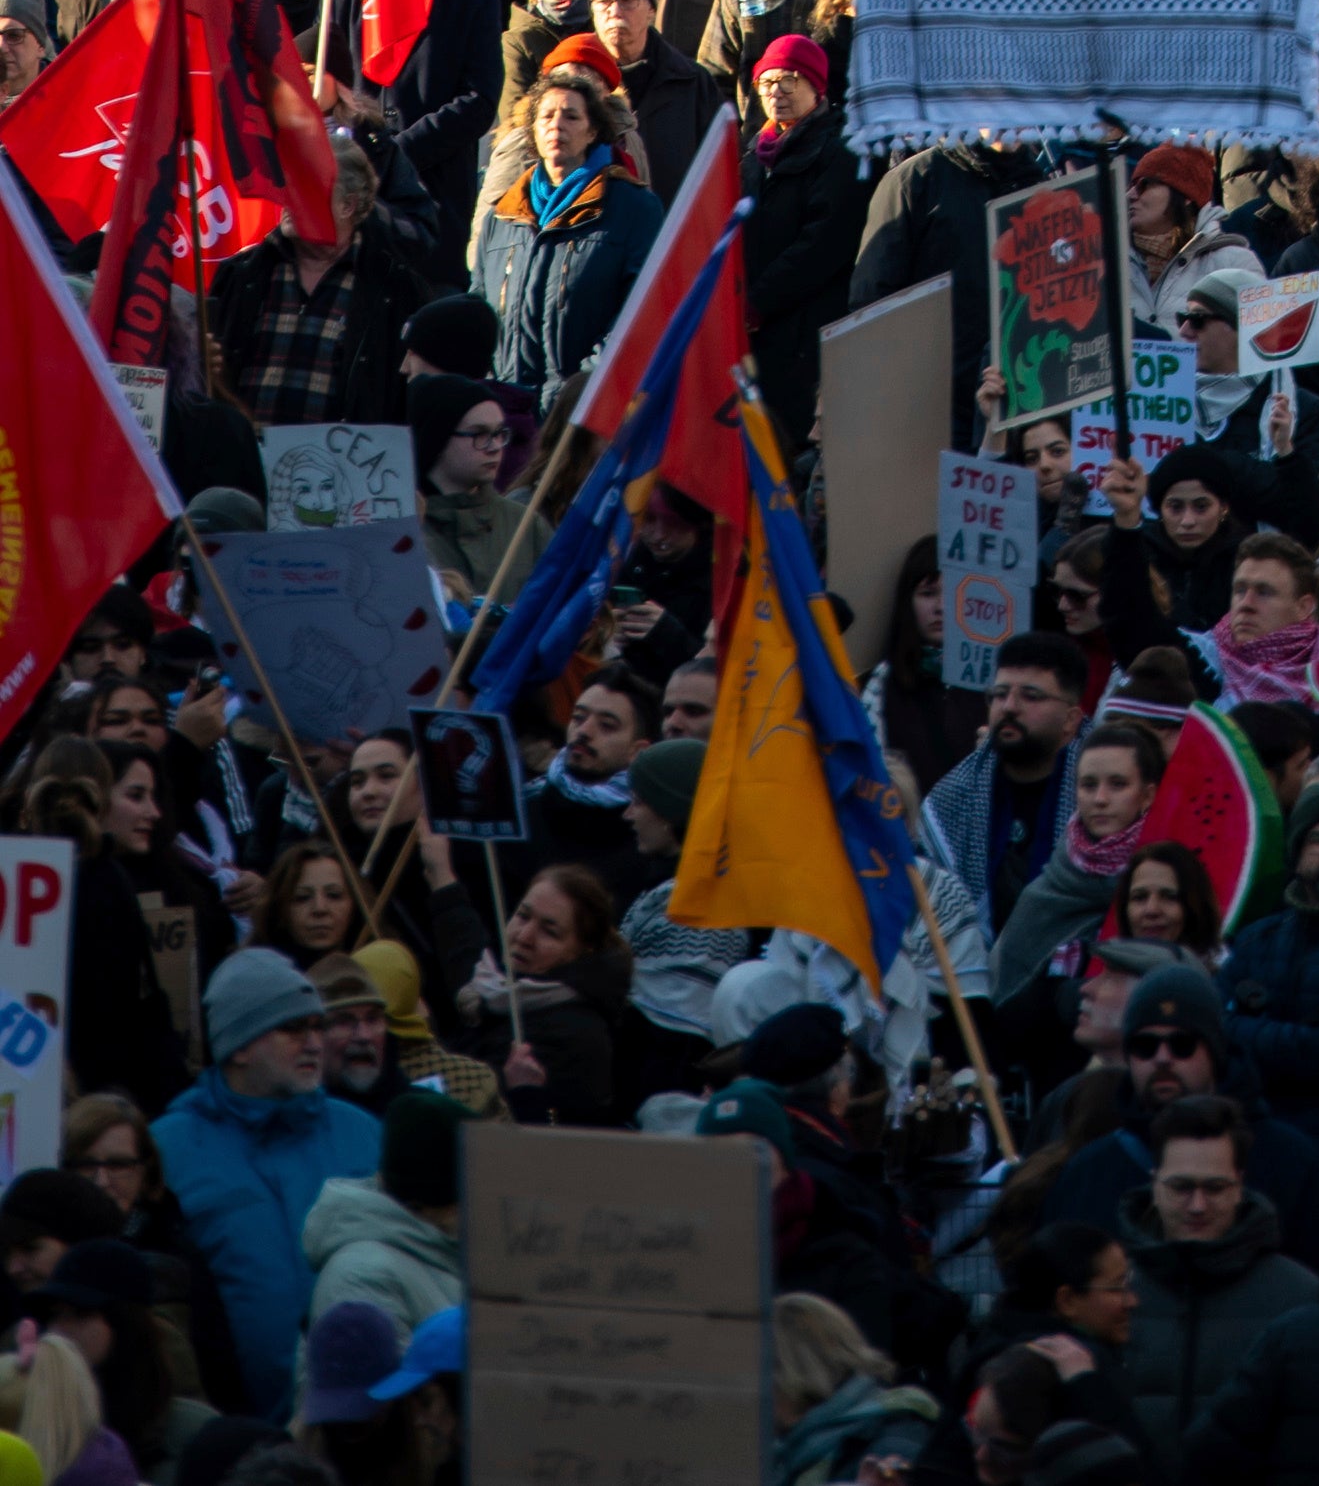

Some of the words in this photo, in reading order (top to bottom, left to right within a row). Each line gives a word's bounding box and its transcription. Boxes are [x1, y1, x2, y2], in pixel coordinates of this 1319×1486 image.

[951, 464, 1016, 501] STOP
[946, 528, 1023, 573] AFD
[962, 596, 1010, 627] STOP
[959, 664, 995, 688] AF
